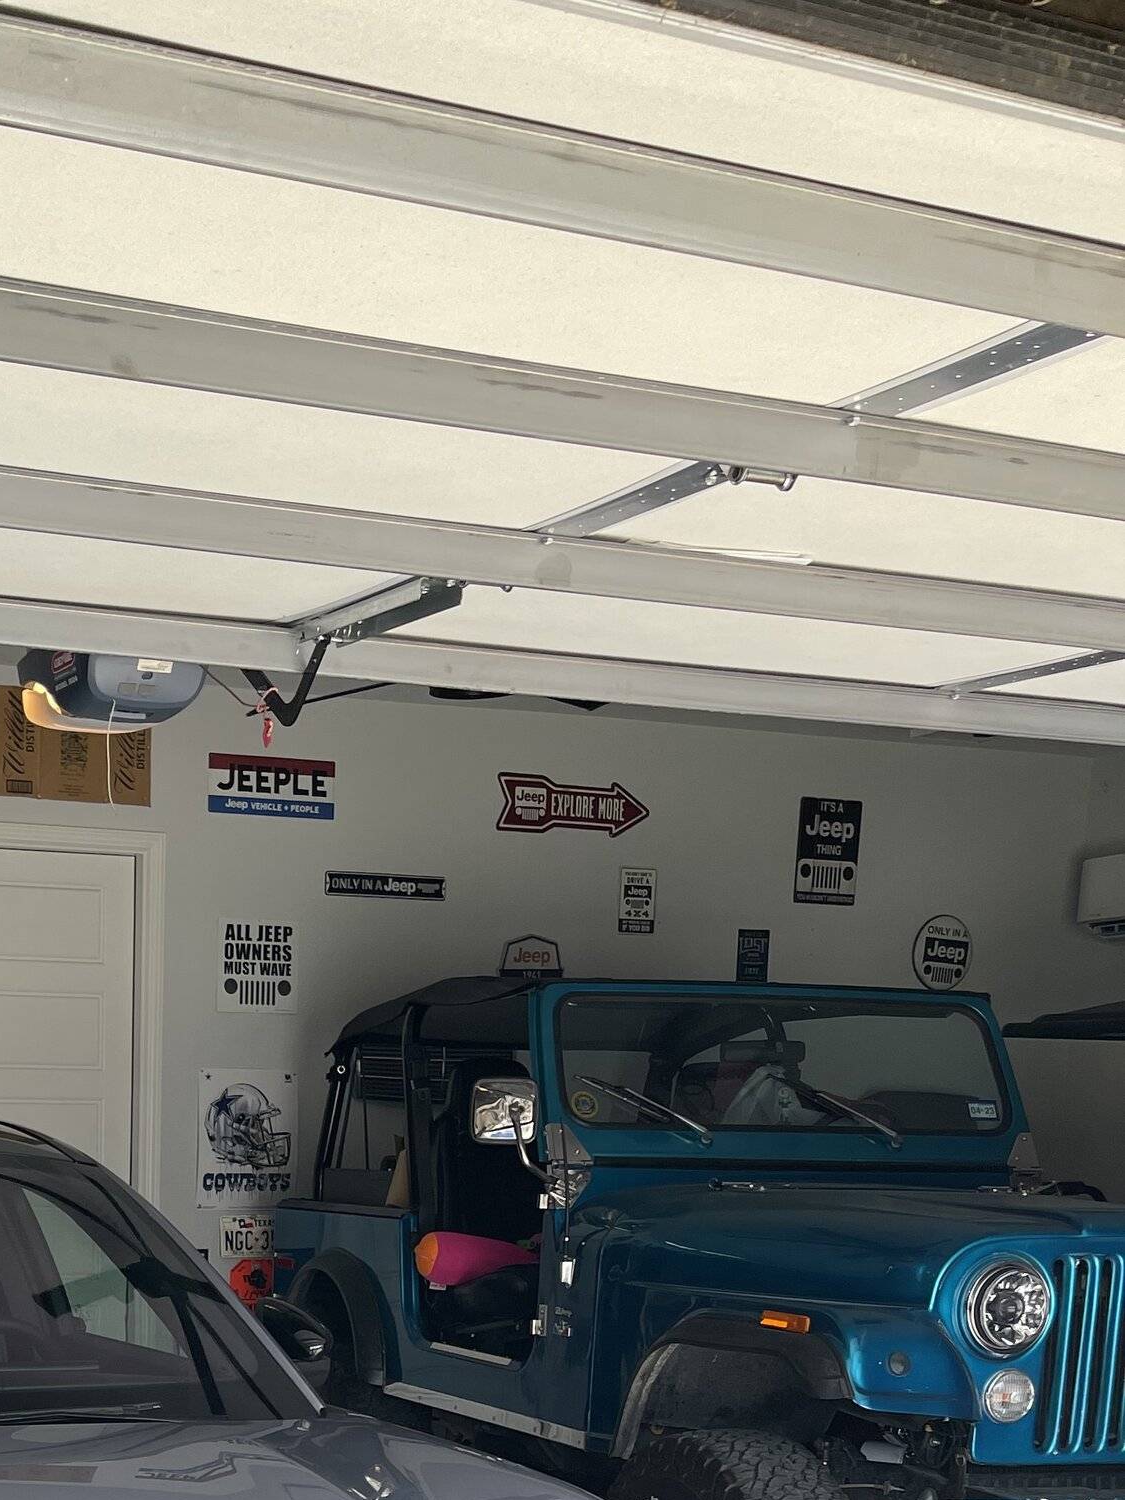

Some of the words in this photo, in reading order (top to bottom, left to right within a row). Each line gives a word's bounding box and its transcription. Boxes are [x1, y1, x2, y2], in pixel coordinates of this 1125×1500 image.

[135, 730, 146, 769] DISTILL
[216, 762, 327, 798] JEEPLE
[224, 798, 249, 811] Jeep
[251, 802, 283, 812] VEHICLE
[290, 804, 320, 814] PEOPLE
[515, 789, 546, 804] Jeep
[550, 793, 595, 819] EXPLORE
[598, 797, 626, 822] MORE
[837, 803, 844, 813] A
[805, 814, 855, 843] Jeep
[816, 844, 842, 856] THING
[331, 877, 361, 890] ONLY
[362, 879, 374, 891] IN
[374, 880, 383, 891] A
[383, 878, 417, 895] Jeep
[224, 924, 253, 941] ALL
[257, 925, 293, 943] JEEP
[927, 925, 951, 936] ONLY
[952, 928, 961, 937] IN
[224, 942, 292, 962] OWNERS
[513, 947, 551, 966] Jeep
[926, 940, 965, 963] Jeep
[223, 961, 257, 976] MUST
[259, 963, 292, 977] WAVE
[202, 1172, 292, 1193] COWBOYS
[254, 1219, 272, 1228] TEXA
